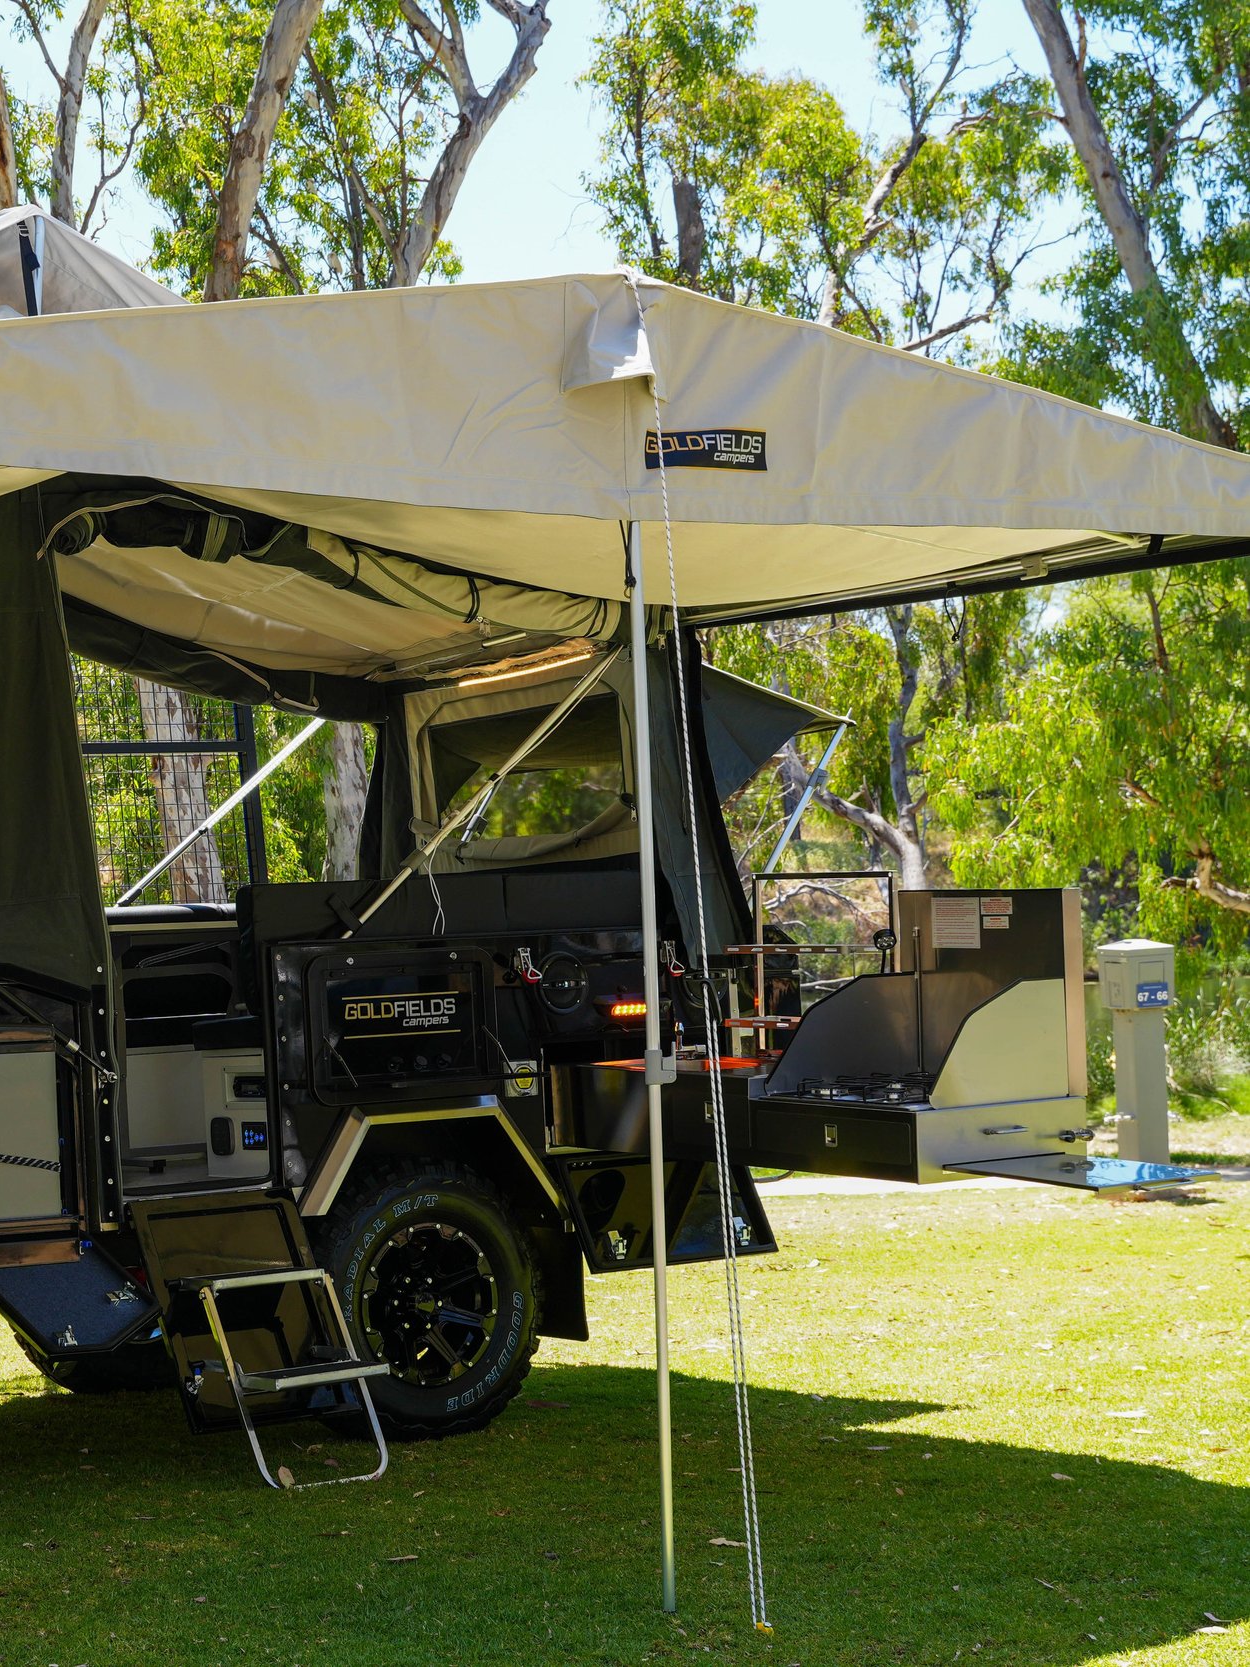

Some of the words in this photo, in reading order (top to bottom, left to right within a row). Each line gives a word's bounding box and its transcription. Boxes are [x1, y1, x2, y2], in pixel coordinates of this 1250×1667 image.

[645, 433, 762, 454] GOLDFIELDS
[713, 452, 755, 464] campers
[1137, 991, 1149, 1002] 67
[344, 998, 456, 1020] GOLDFIELDS
[402, 1015, 450, 1028] campers
[343, 1218, 387, 1322] RADIAL
[446, 1290, 525, 1413] GOODRIDE
